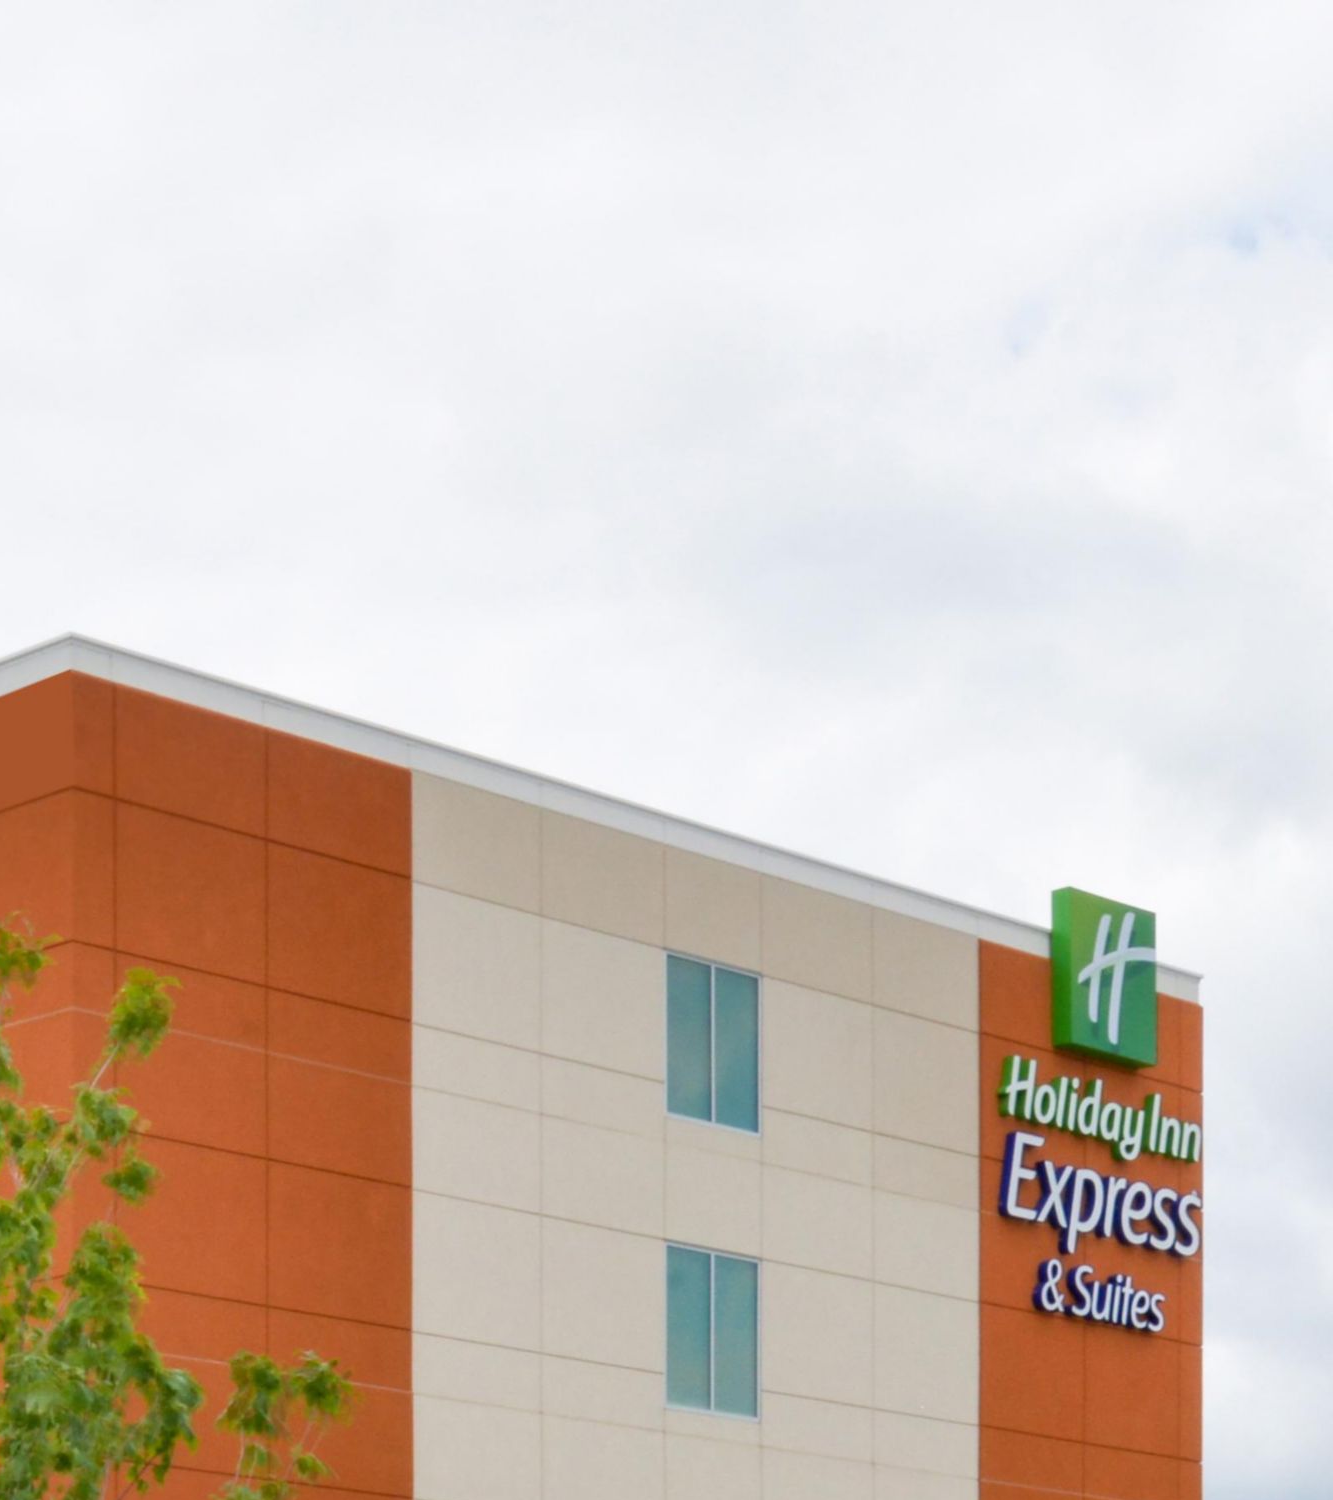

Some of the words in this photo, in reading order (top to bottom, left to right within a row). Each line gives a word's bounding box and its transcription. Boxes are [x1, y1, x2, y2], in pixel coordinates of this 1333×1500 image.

[998, 1055, 1144, 1161] Holiday
[1146, 1093, 1201, 1163] Inn
[999, 1131, 1203, 1257] Express
[1033, 1258, 1065, 1314] &
[1067, 1264, 1165, 1333] Suites
